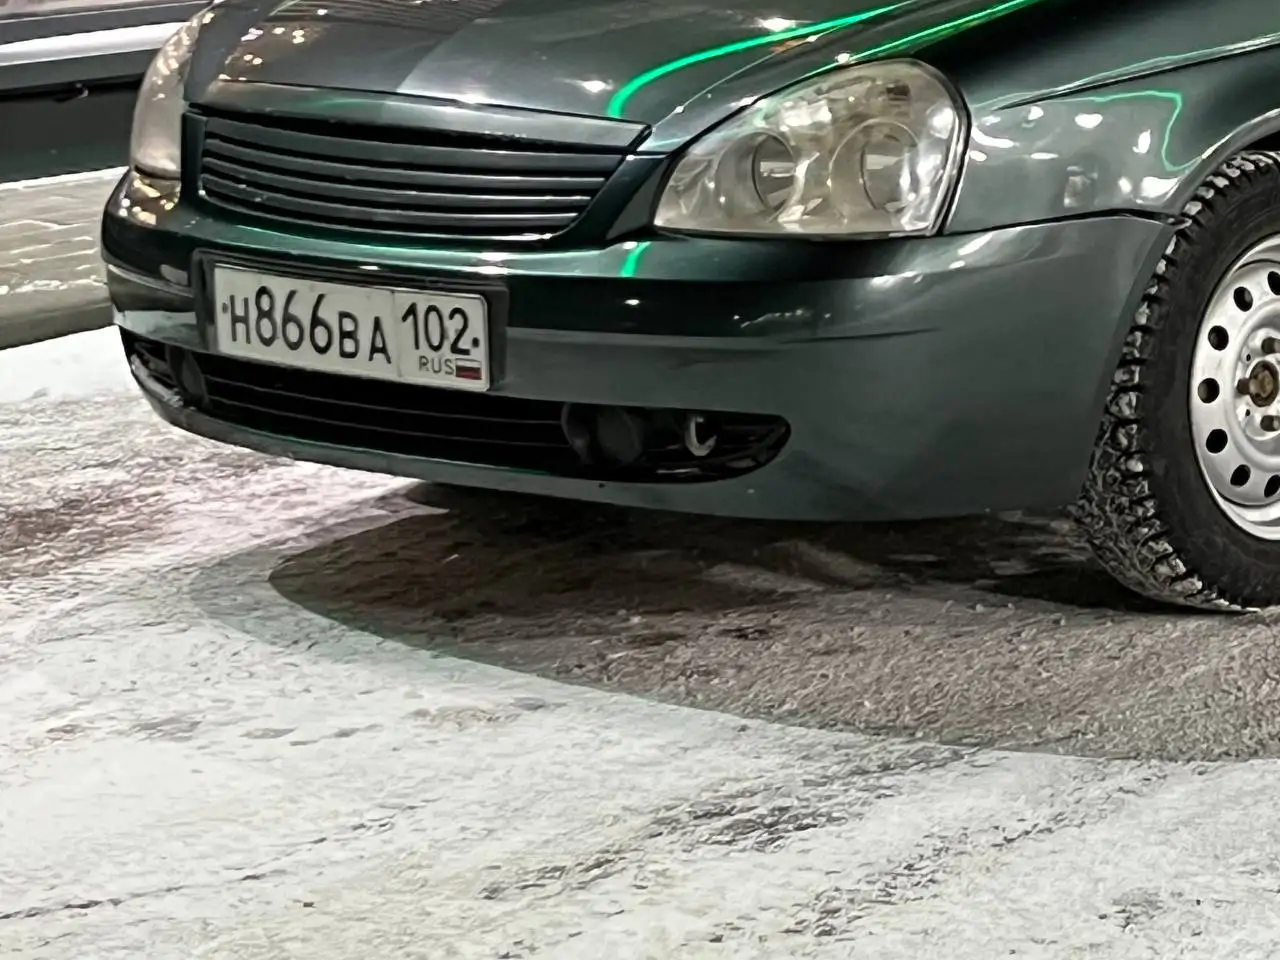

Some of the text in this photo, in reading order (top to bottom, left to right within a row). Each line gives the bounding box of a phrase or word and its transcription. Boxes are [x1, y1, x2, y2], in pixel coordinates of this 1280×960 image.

[229, 285, 471, 365] Н866ВА 102
[418, 355, 455, 376] RUS
